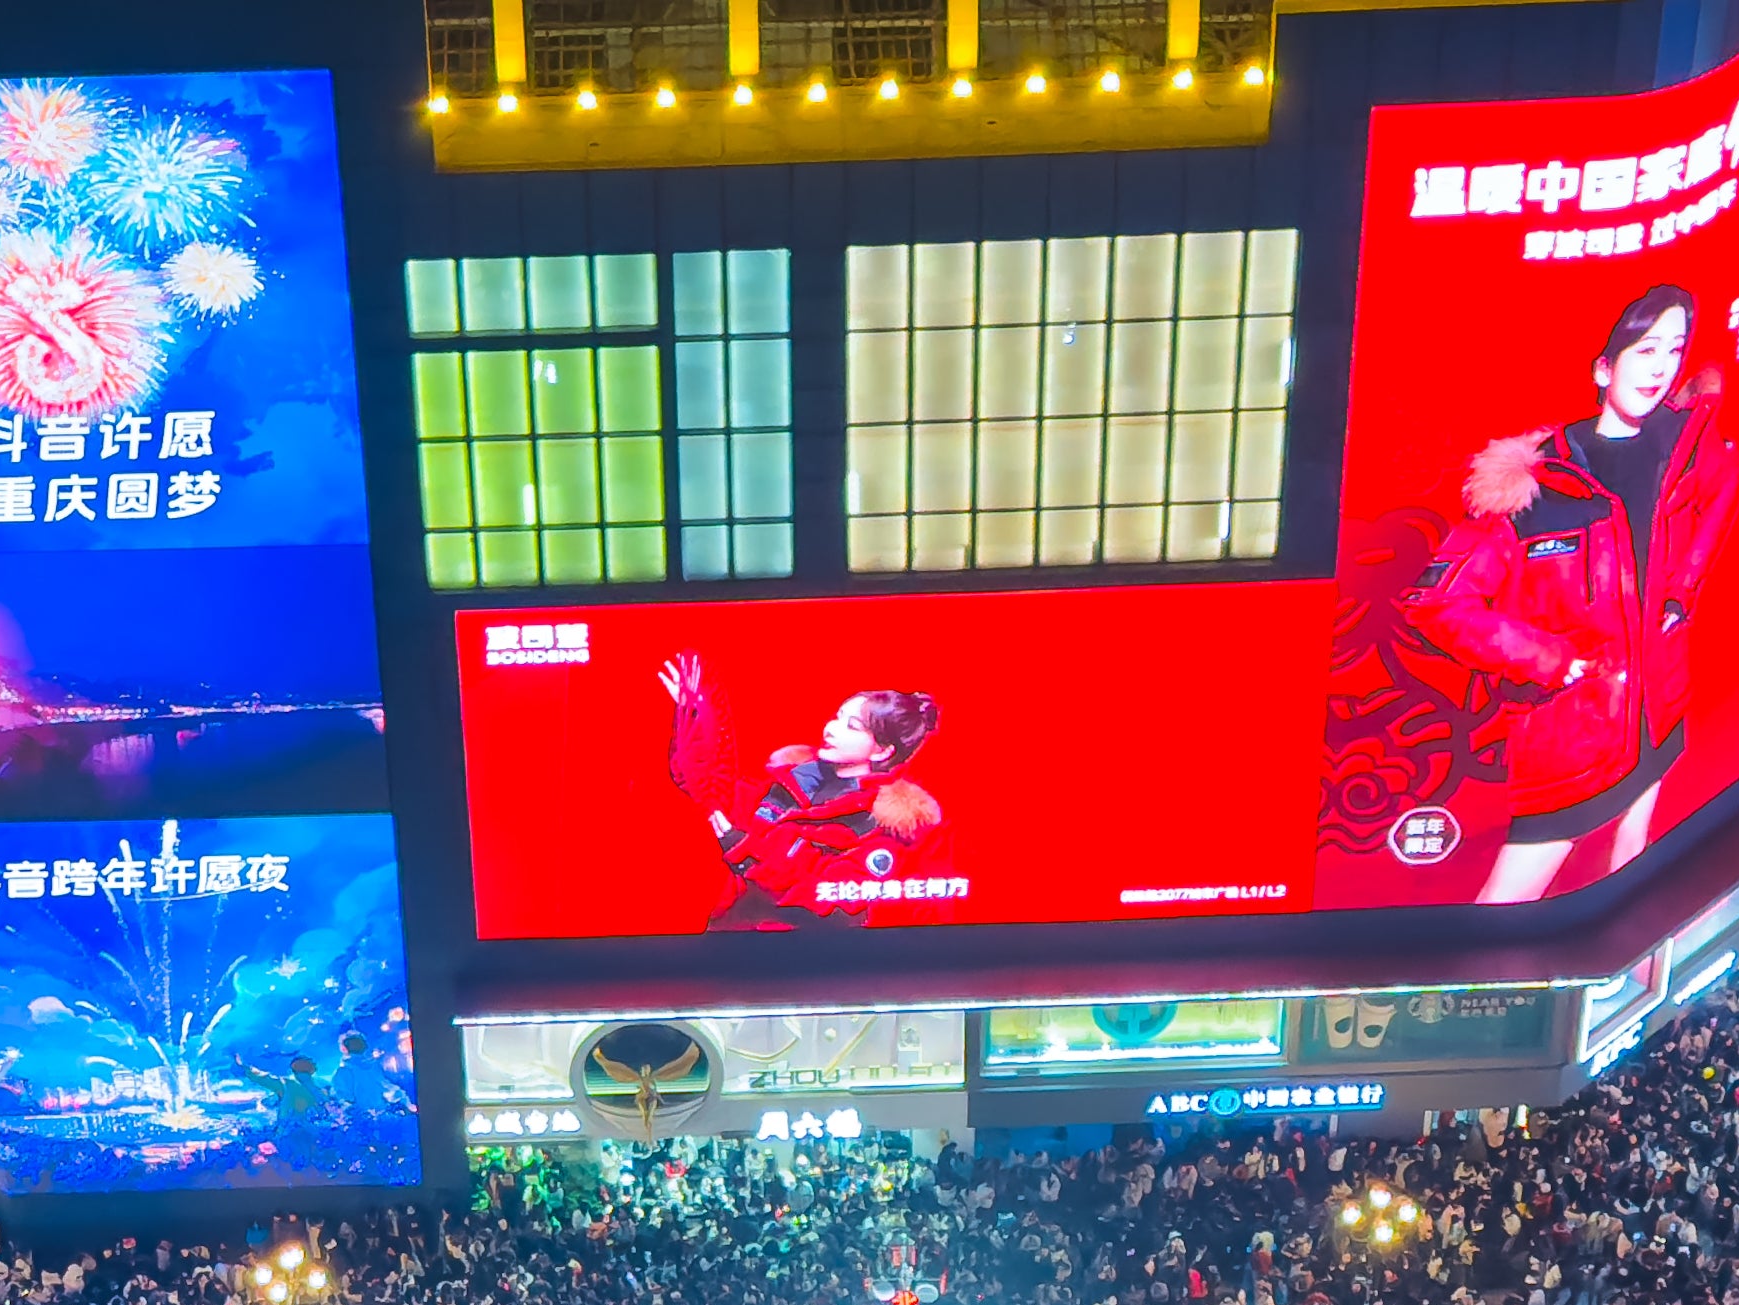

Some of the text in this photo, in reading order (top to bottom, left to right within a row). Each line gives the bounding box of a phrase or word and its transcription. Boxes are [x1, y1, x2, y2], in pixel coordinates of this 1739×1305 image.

[1405, 818, 1446, 838] 新年
[815, 878, 970, 902] 无论你身在何方
[1148, 1096, 1210, 1116] ABC
